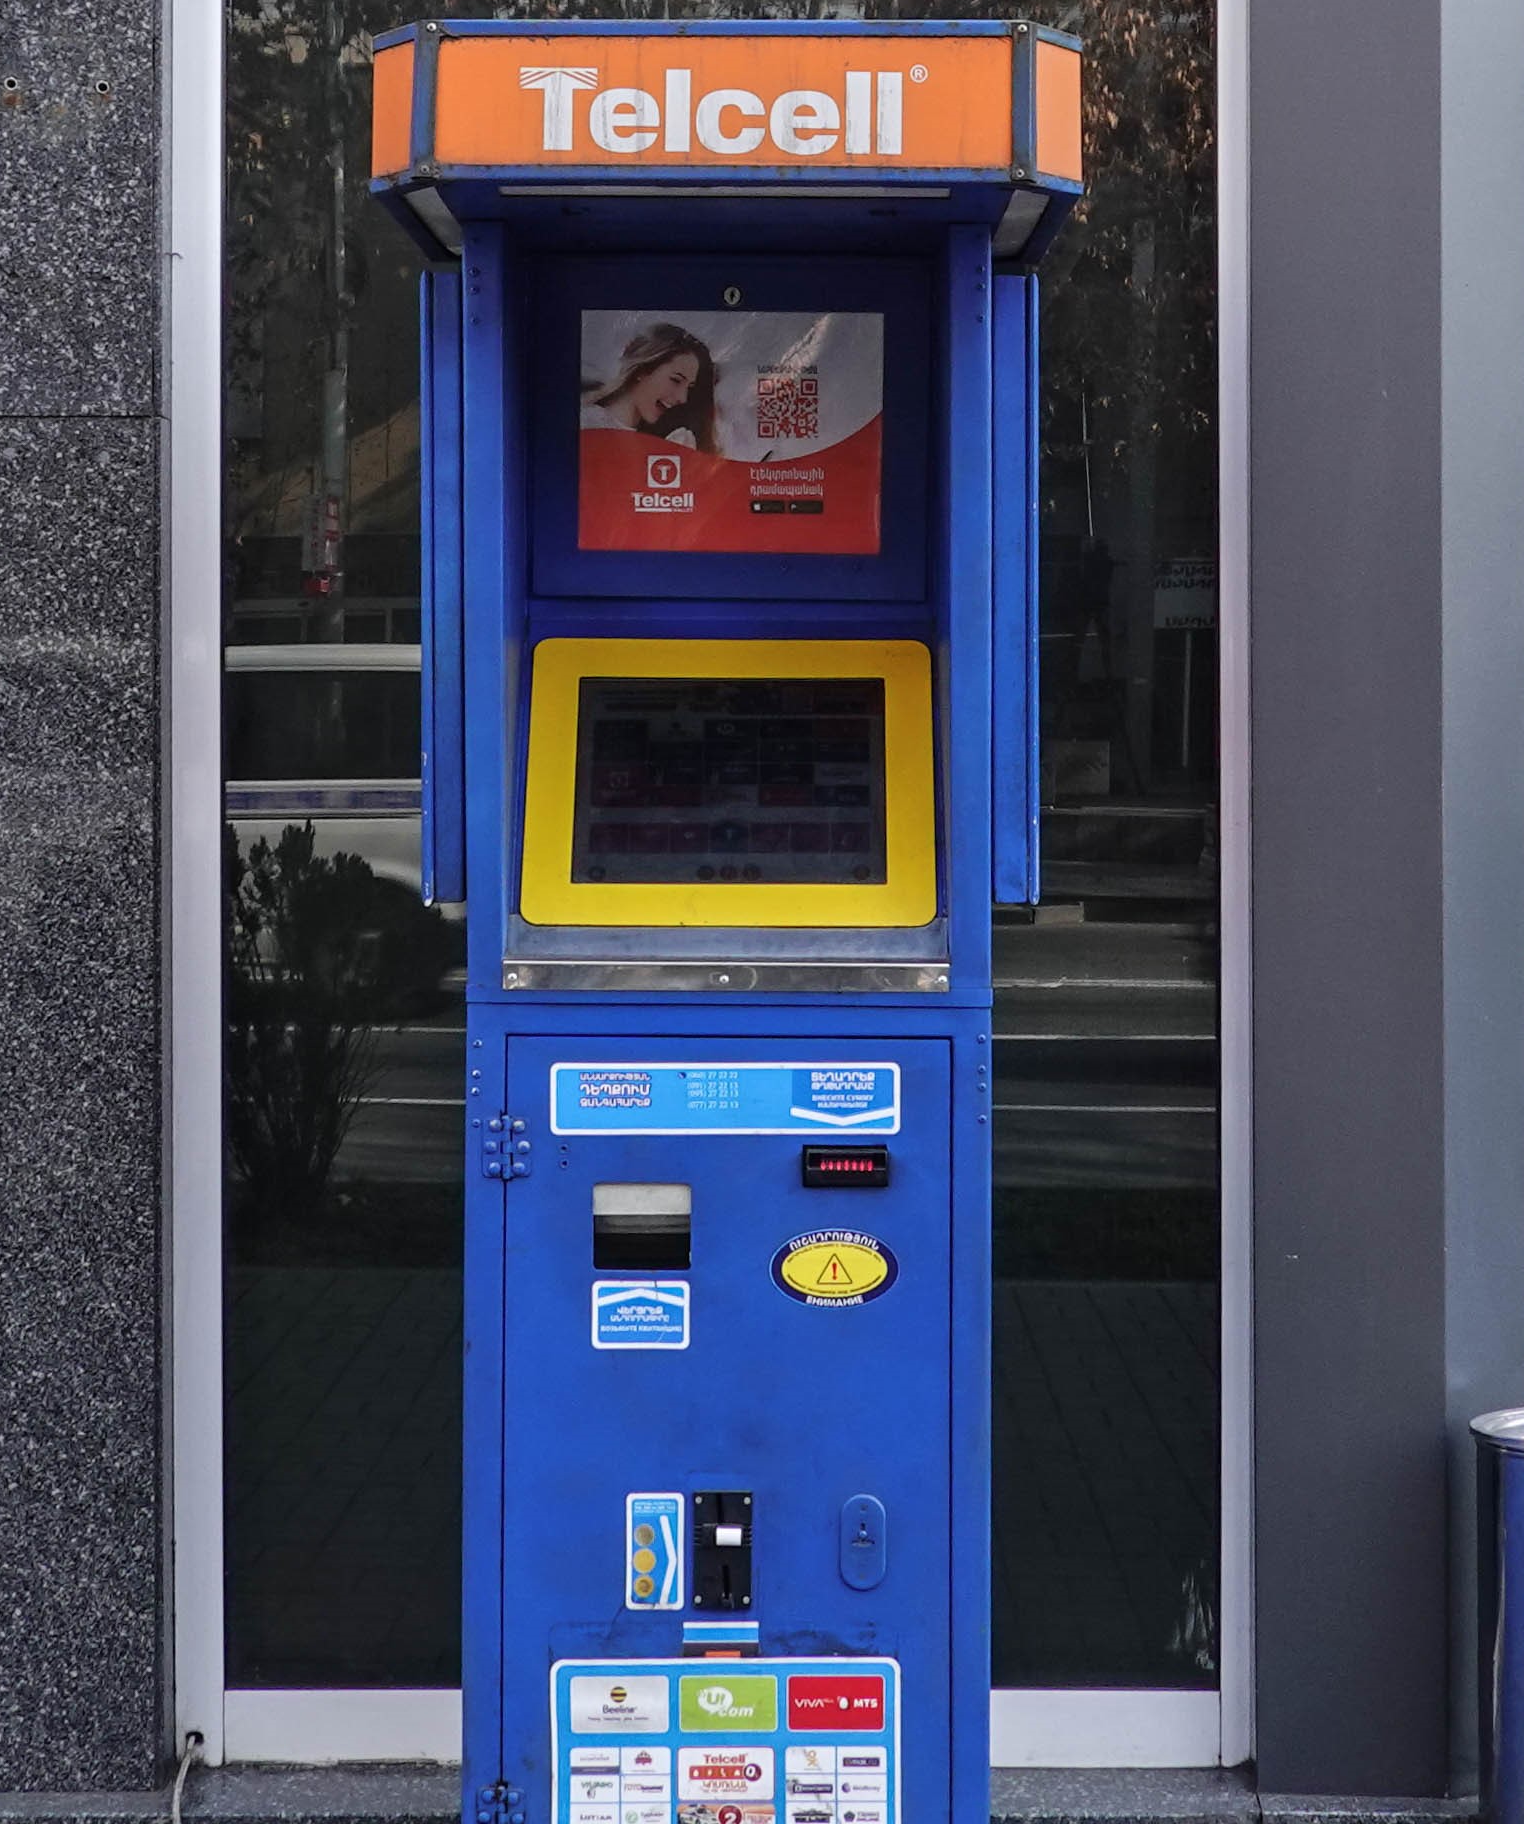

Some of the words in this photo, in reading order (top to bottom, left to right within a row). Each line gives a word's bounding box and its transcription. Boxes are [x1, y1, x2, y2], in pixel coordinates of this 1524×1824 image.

[519, 66, 903, 156] Telcell
[631, 492, 694, 508] Telcell
[806, 1295, 864, 1307] ВНИМАНИЕ
[854, 1698, 878, 1708] MTS
[704, 1754, 746, 1764] Telcell
